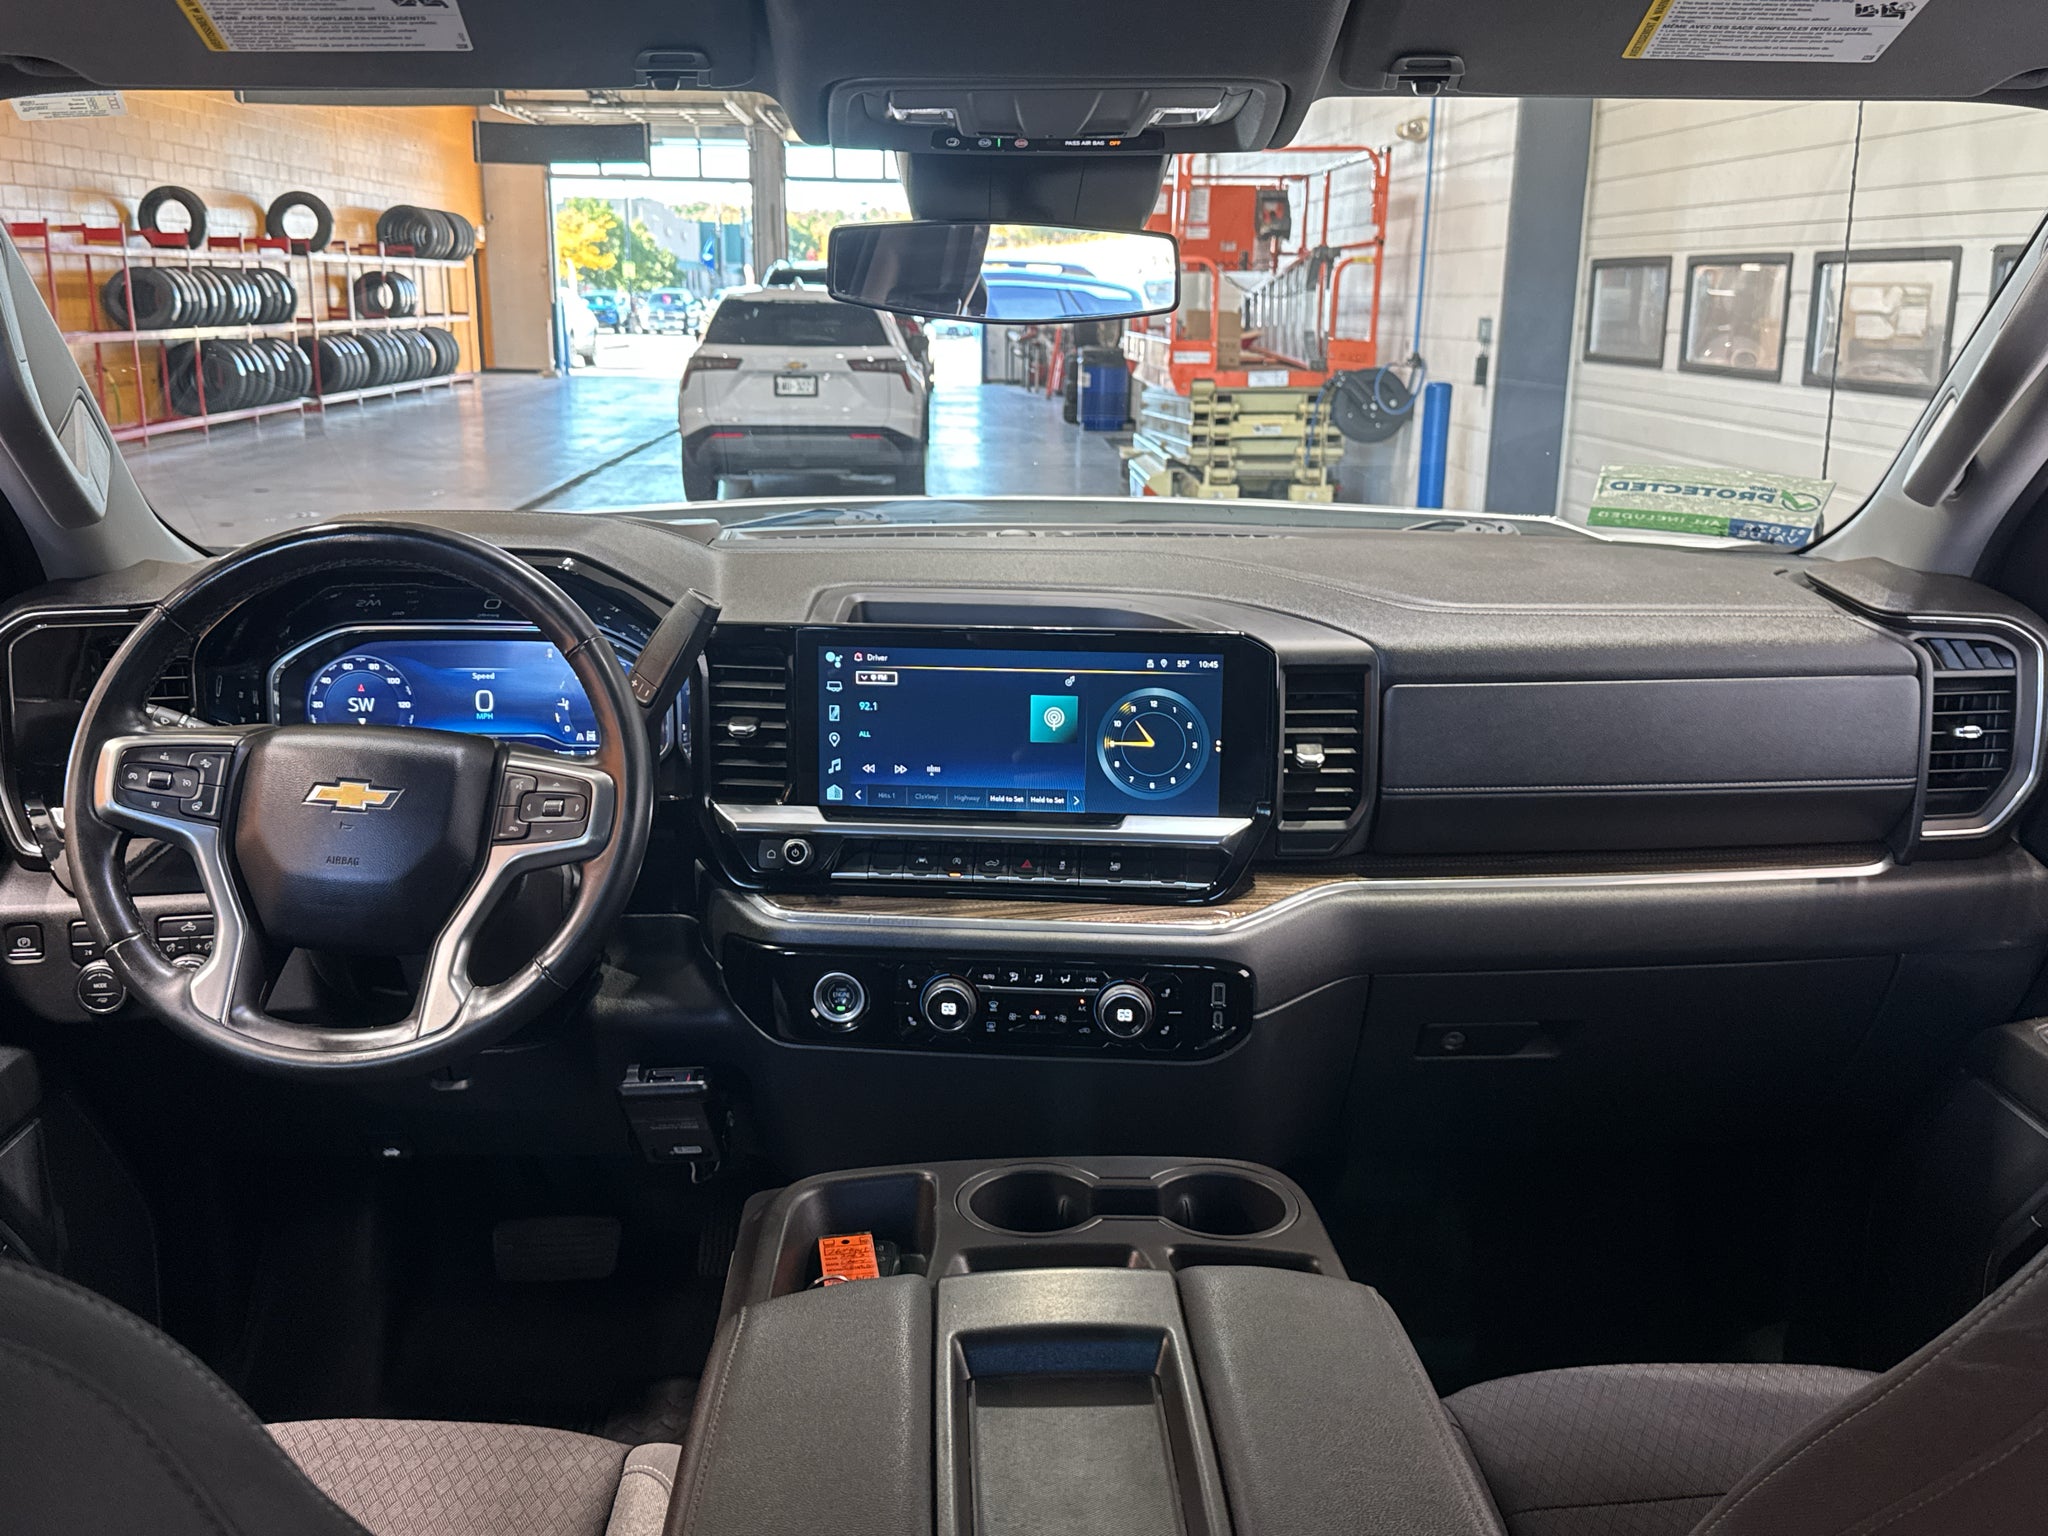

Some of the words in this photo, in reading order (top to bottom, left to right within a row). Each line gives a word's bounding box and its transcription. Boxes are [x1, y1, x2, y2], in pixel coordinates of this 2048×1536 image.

[867, 654, 889, 662] Driver
[1198, 660, 1219, 669] 10:45
[472, 672, 495, 681] Speed
[347, 697, 375, 713] SW
[475, 689, 495, 713] 0
[1150, 700, 1158, 708] 12
[859, 702, 878, 712] 92.1
[476, 712, 494, 720] MPH
[1113, 720, 1122, 728] 10
[1129, 775, 1135, 783] 7
[953, 794, 981, 803] Highway
[326, 856, 360, 866] AIRBAG
